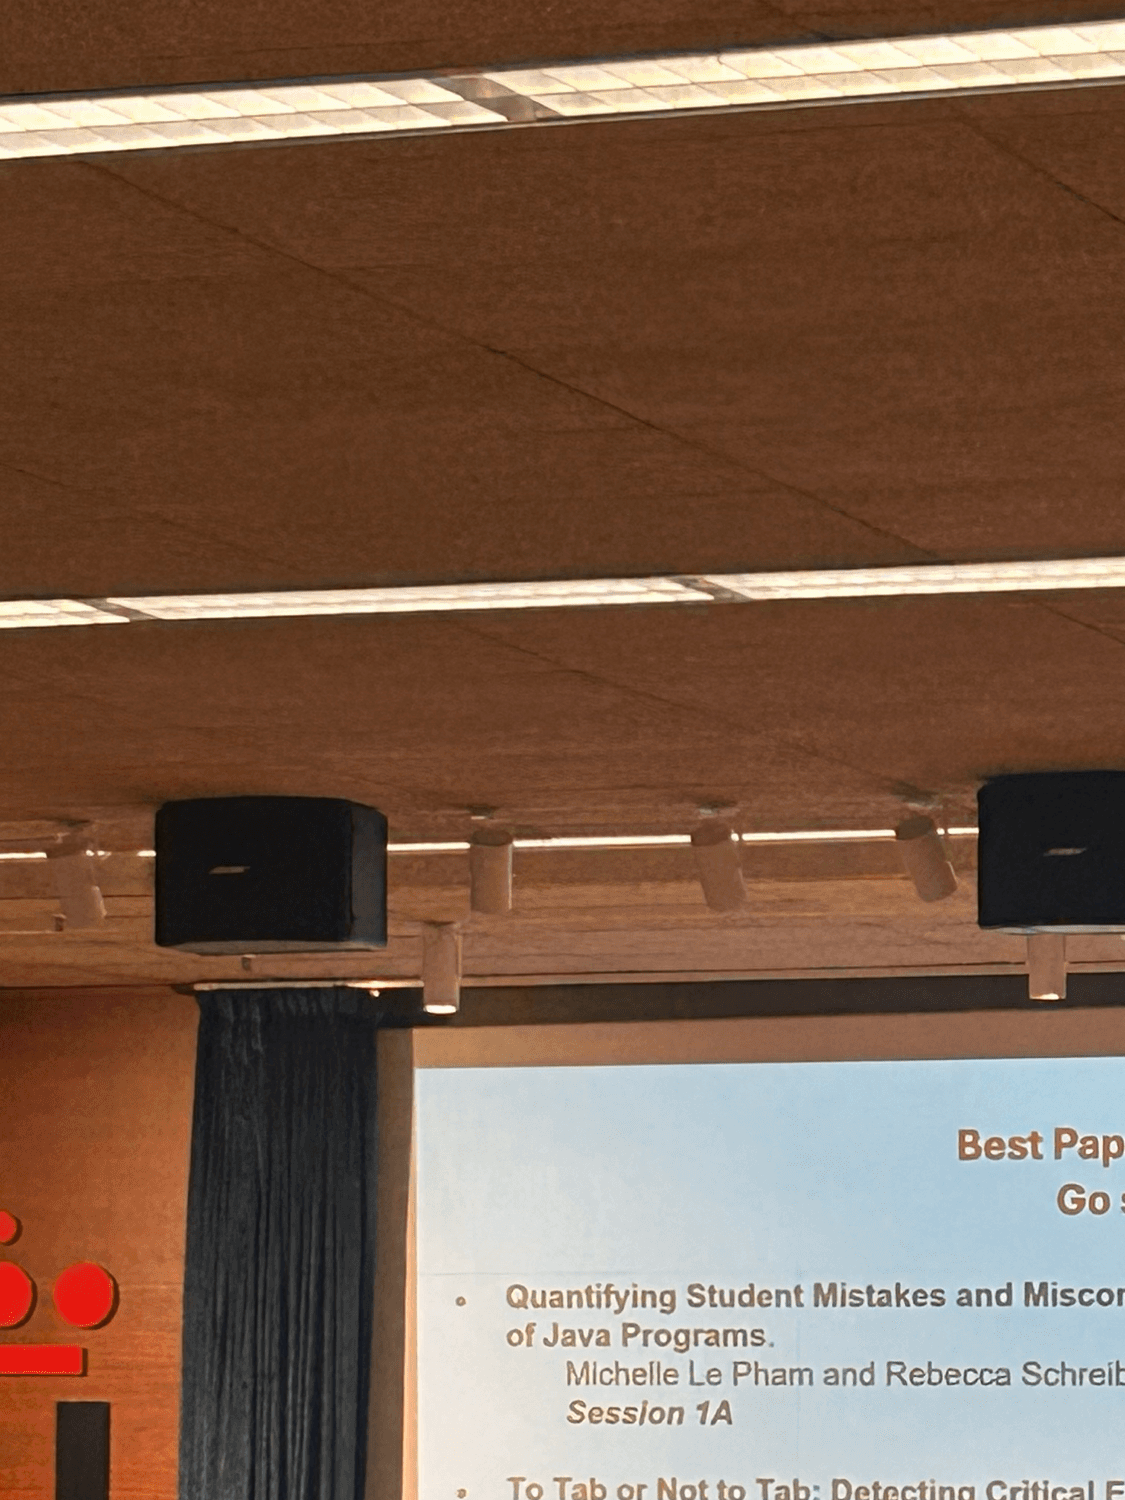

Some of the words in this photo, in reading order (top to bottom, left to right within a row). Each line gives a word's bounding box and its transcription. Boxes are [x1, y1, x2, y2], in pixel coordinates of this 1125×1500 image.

[958, 1129, 1044, 1161] Best
[1057, 1184, 1110, 1215] Go
[506, 1283, 676, 1315] Quantifying
[687, 1283, 804, 1308] Student
[813, 1282, 946, 1307] Mistakes
[956, 1282, 1012, 1307] and
[506, 1322, 536, 1347] of
[543, 1322, 611, 1347] Java
[622, 1322, 774, 1354] Programs.
[567, 1361, 679, 1386] Michelle
[689, 1359, 722, 1386] Le
[732, 1361, 813, 1386] Pham
[823, 1361, 875, 1386] and
[886, 1361, 1011, 1386] Rebecca
[567, 1400, 684, 1426] Session
[696, 1400, 732, 1426] 1A
[507, 1477, 543, 1500] To
[553, 1477, 607, 1500] Tab
